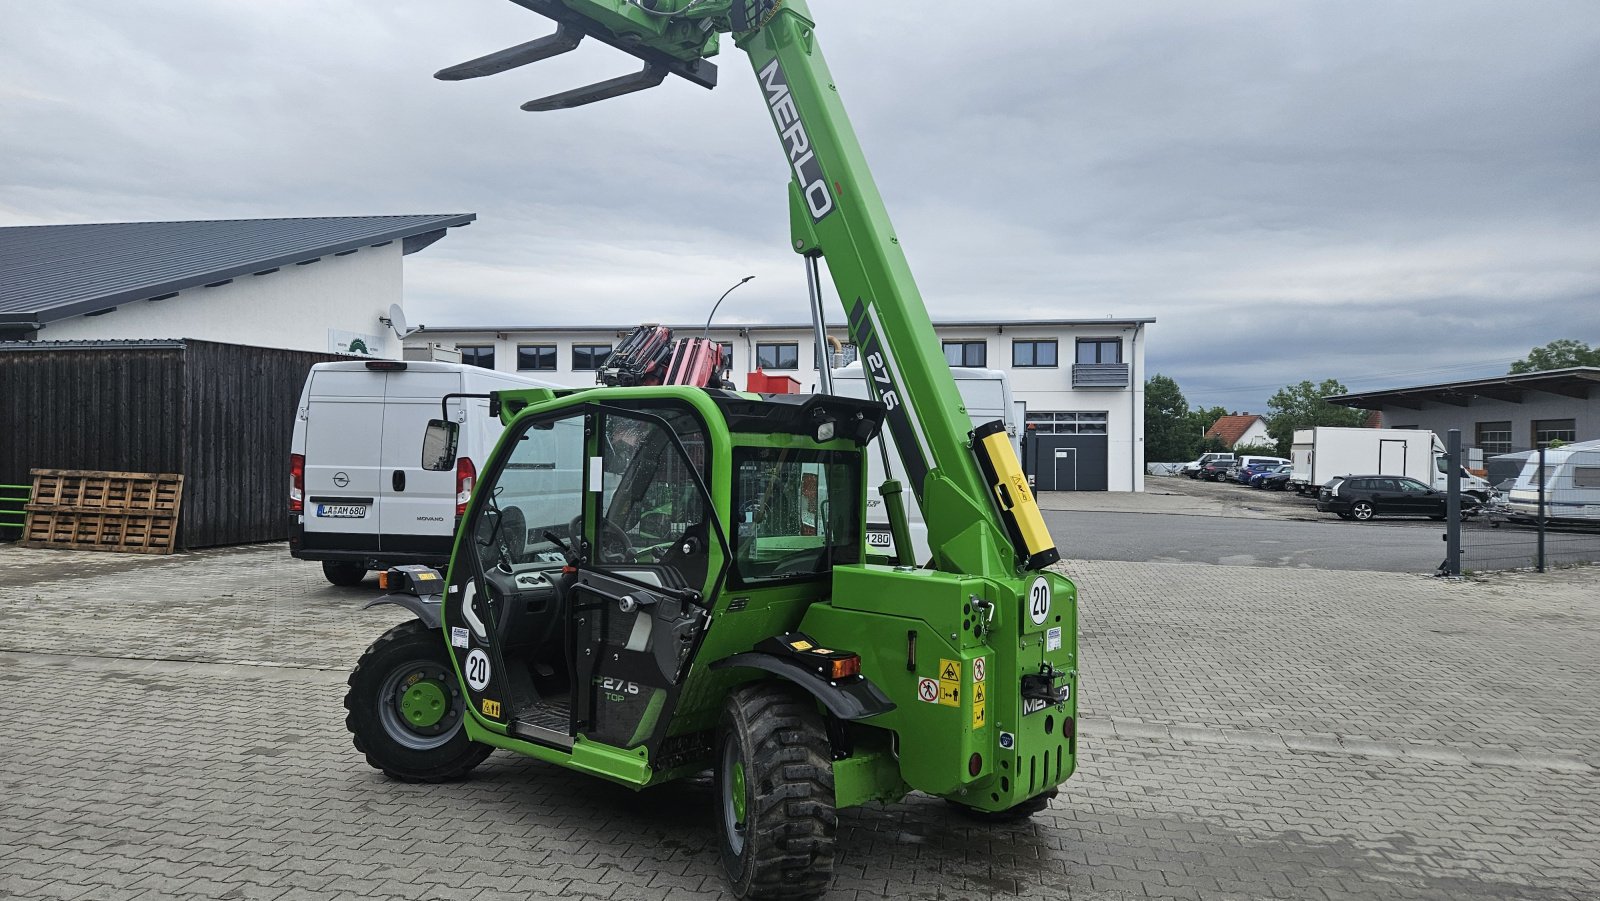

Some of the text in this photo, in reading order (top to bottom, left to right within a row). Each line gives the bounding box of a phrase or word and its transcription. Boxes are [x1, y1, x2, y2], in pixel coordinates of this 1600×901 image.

[759, 59, 832, 218] MERLO
[867, 352, 899, 411] 27.6
[350, 506, 364, 515] 680
[871, 534, 889, 543] 280
[1033, 585, 1047, 616] 20
[469, 655, 486, 684] 20
[604, 691, 625, 703] TOP
[1023, 685, 1069, 715] MEO
